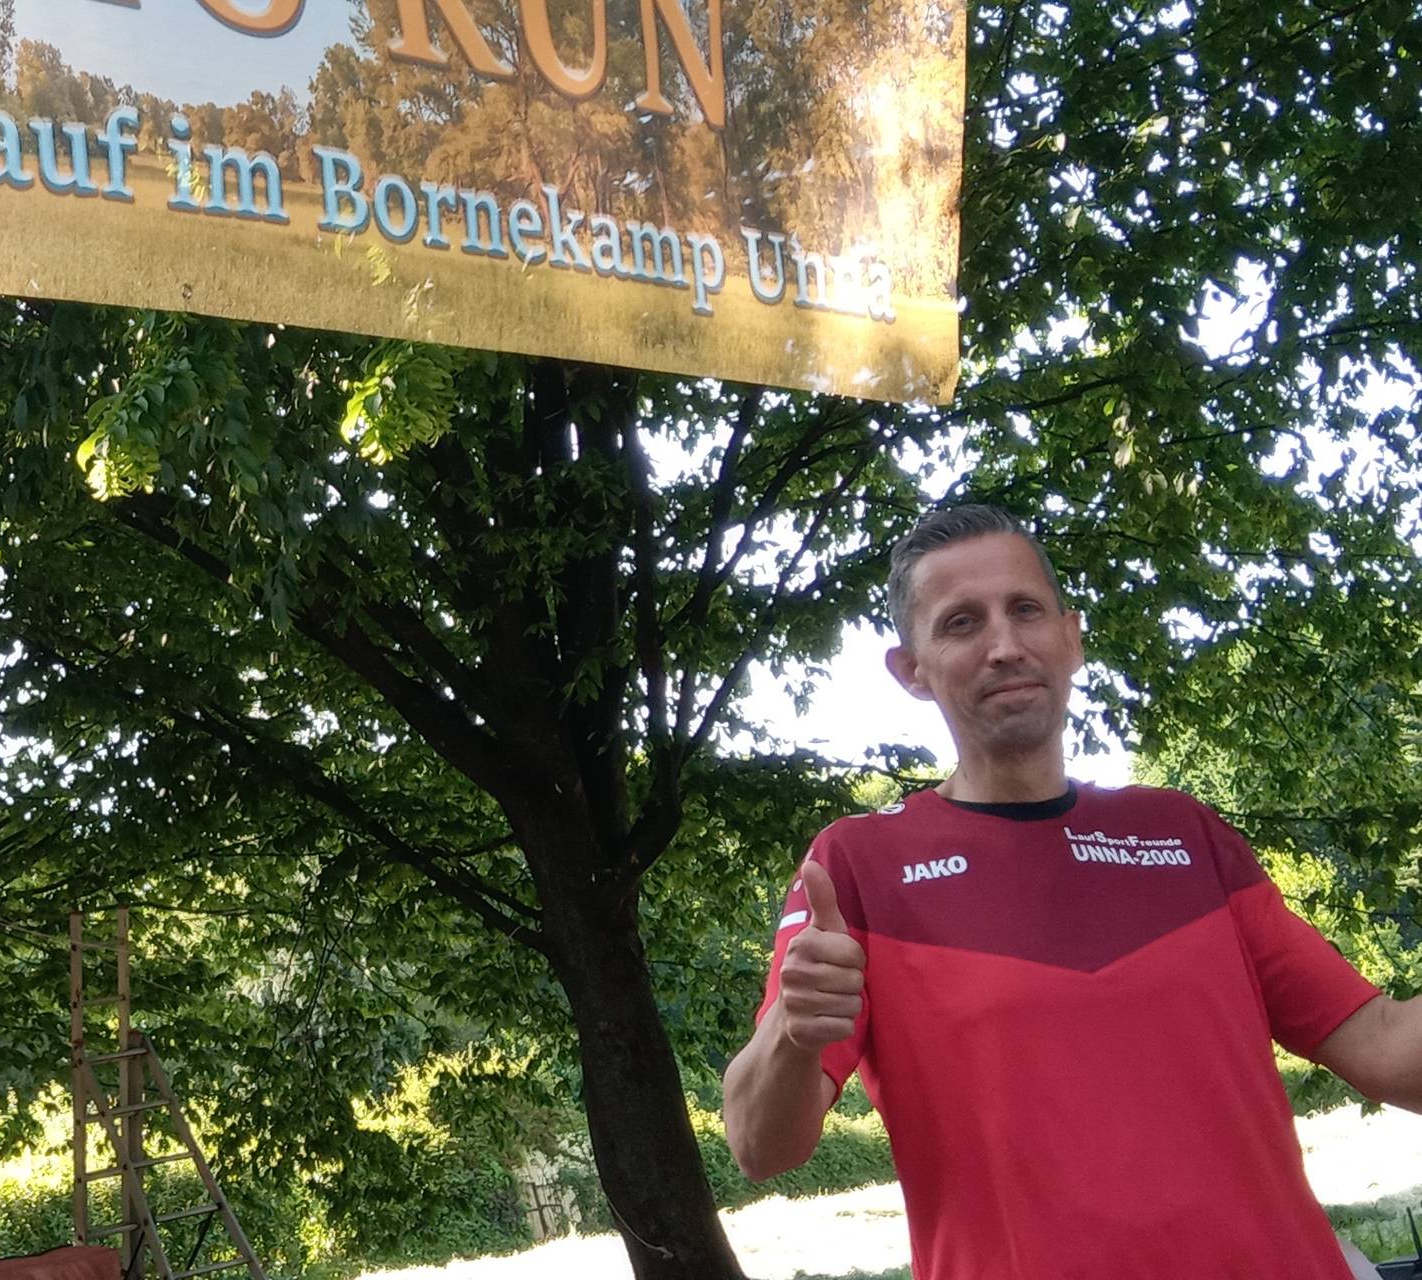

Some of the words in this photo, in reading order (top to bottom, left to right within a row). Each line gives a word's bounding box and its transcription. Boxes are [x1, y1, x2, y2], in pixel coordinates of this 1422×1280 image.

[166, 110, 290, 225] im
[312, 143, 727, 317] Bornekamp
[1070, 843, 1192, 866] UNNA-2000
[900, 855, 969, 885] JAKO
